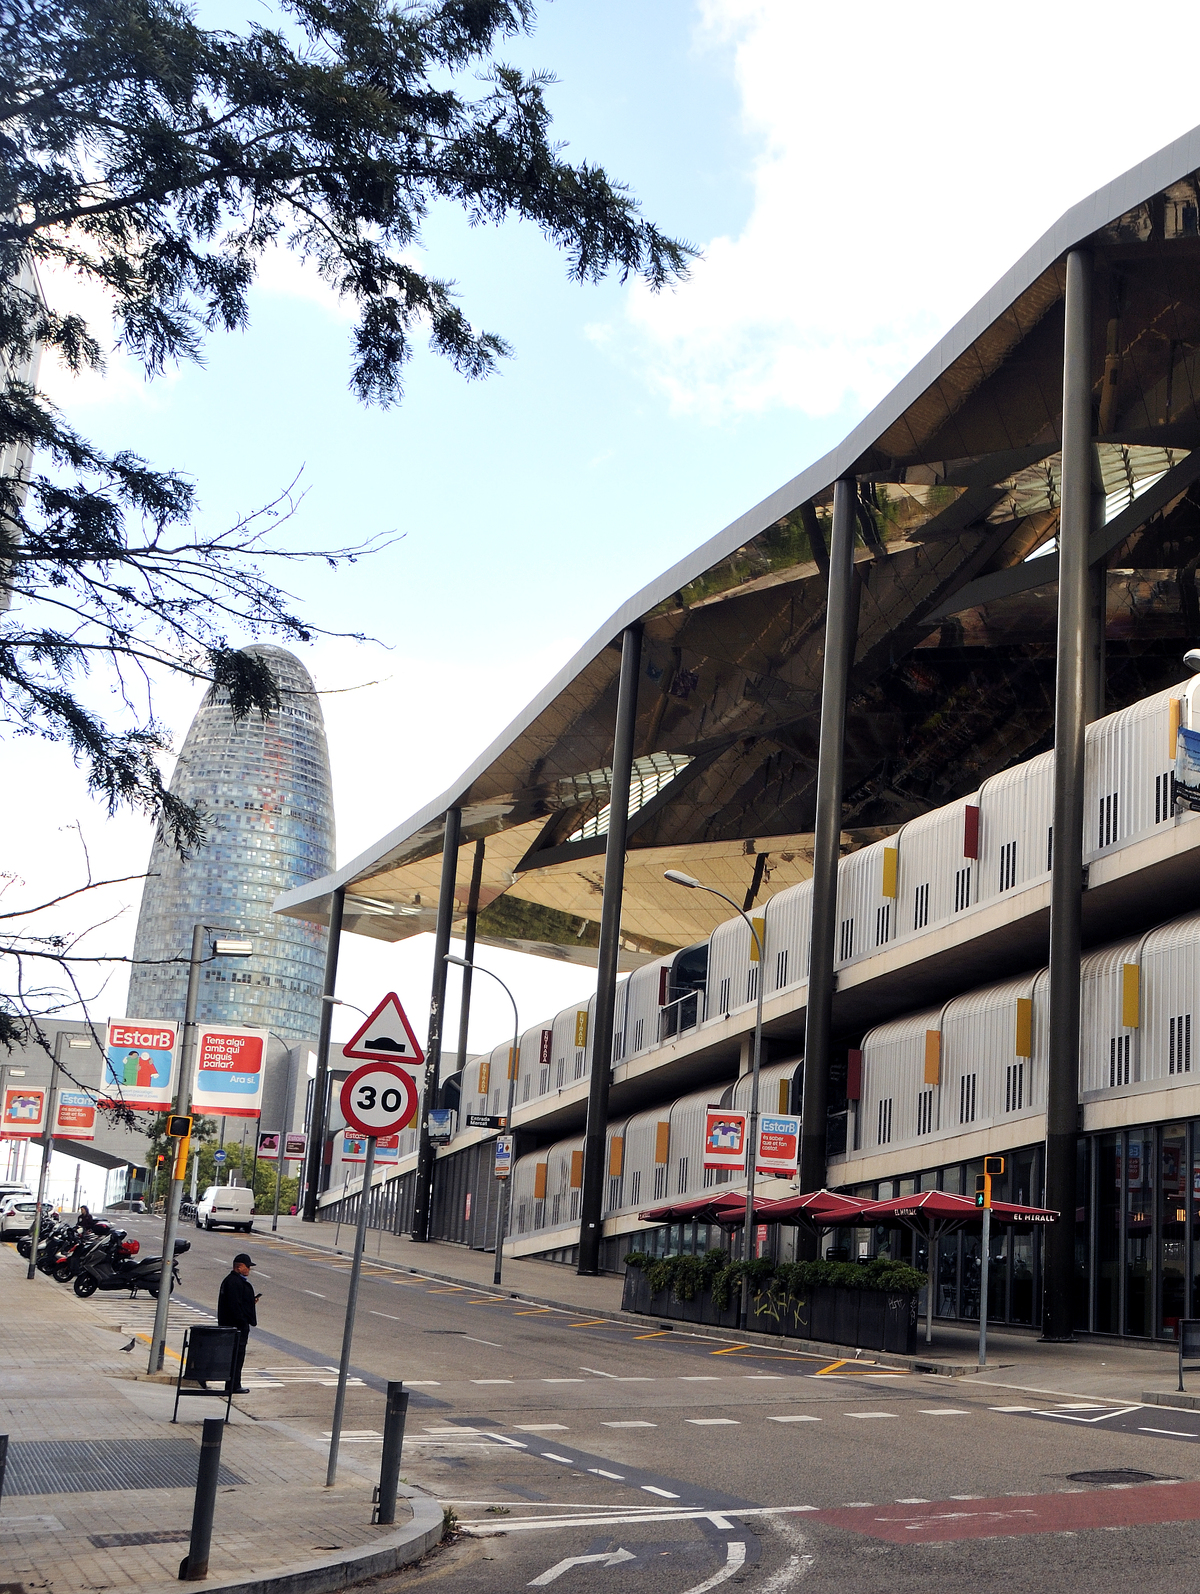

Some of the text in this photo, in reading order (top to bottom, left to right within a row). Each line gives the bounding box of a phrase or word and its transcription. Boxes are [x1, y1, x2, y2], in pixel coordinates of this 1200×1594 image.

[577, 1012, 585, 1046] ENTRADA
[112, 1028, 171, 1047] EstarB
[206, 1036, 245, 1047] Tens algú
[205, 1045, 225, 1053] amb
[204, 1053, 232, 1062] puguis
[203, 1060, 234, 1069] parlar?
[230, 1075, 246, 1083] Ara
[357, 1086, 402, 1112] 30
[500, 1118, 506, 1126] E
[763, 1120, 796, 1132] EstarB
[498, 1143, 503, 1152] P
[1024, 1214, 1055, 1222] MIRALL
